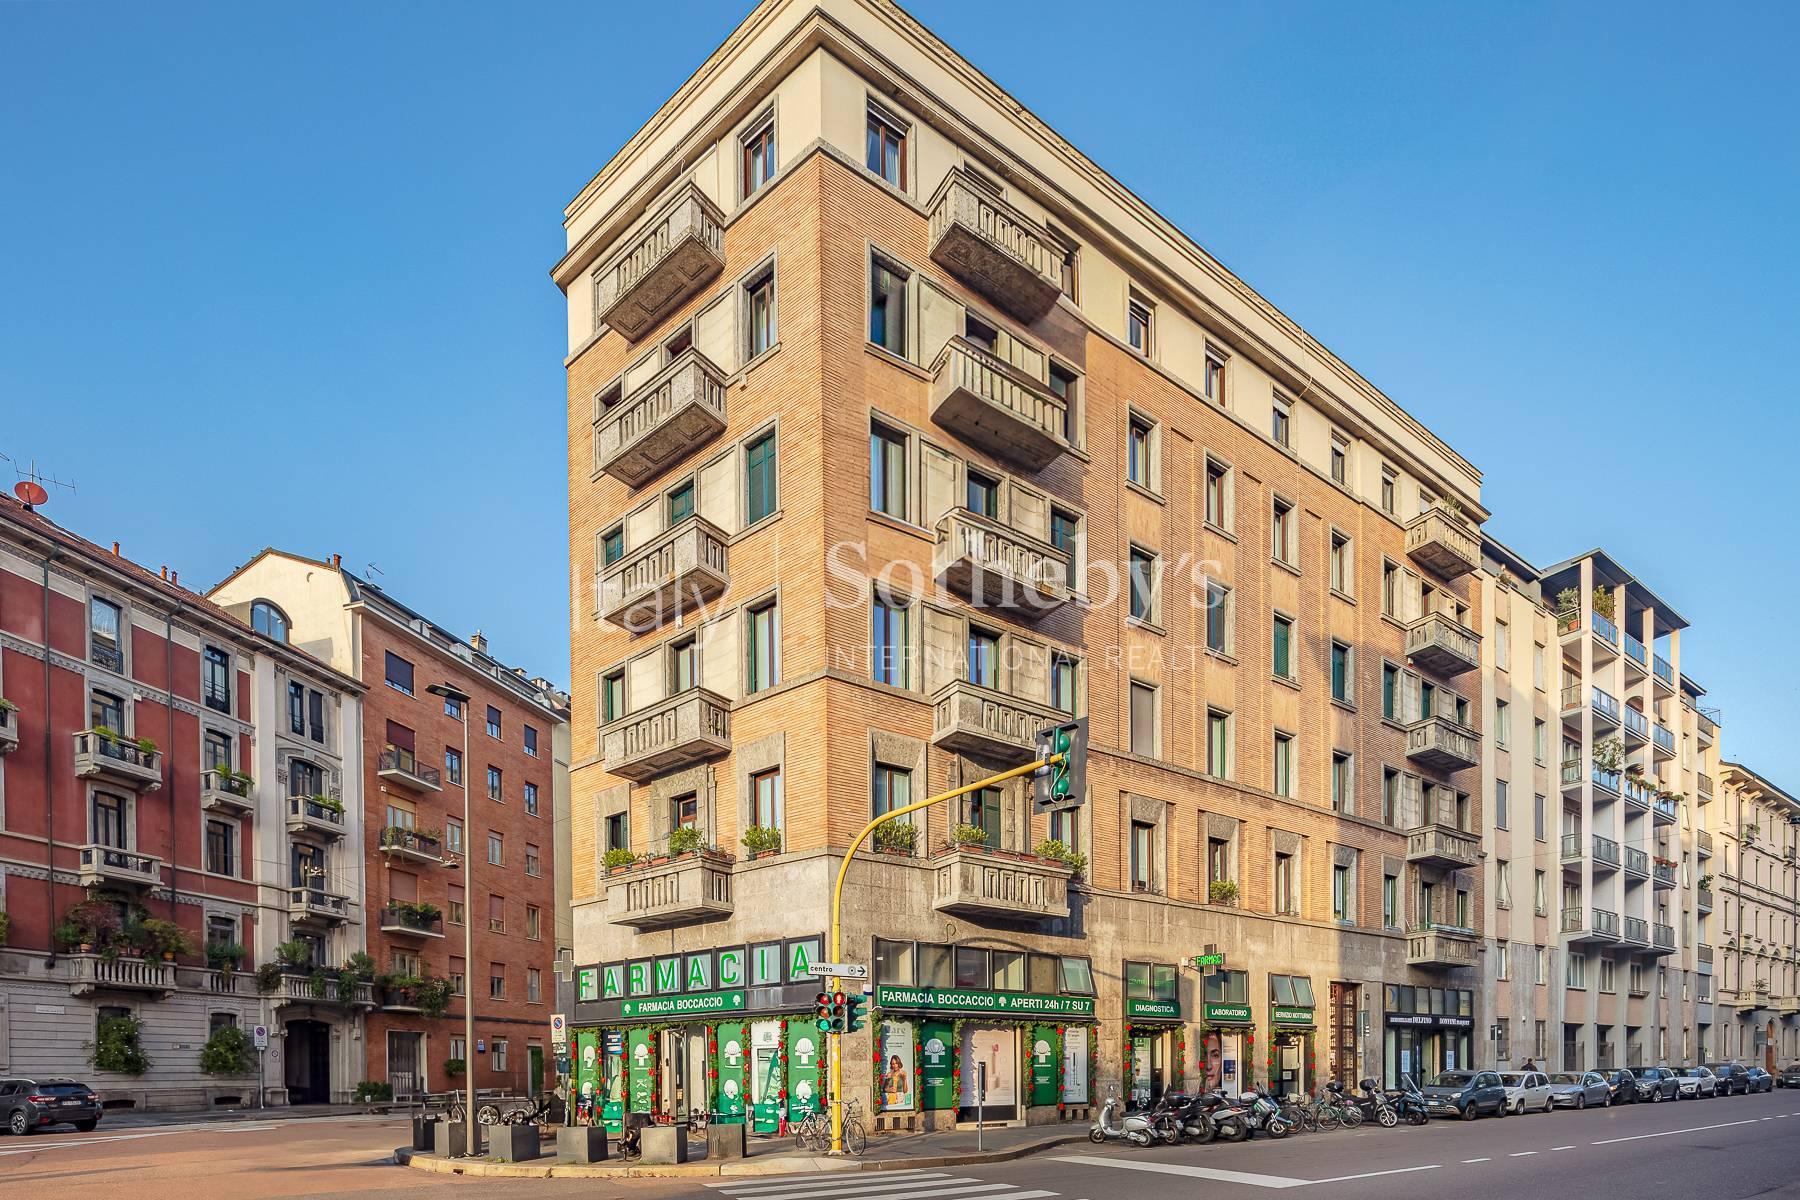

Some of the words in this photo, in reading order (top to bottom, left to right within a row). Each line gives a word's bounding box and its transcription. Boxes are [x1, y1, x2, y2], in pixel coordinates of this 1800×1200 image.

[579, 944, 810, 998] FARMACIA
[810, 965, 833, 973] centro
[881, 990, 935, 1004] FARMACIA
[937, 993, 994, 1007] BOCCACCIO
[638, 1001, 675, 1013] FARMACIA
[676, 997, 723, 1010] BOCCACCIO
[1010, 998, 1043, 1009] APERTI
[1044, 999, 1059, 1010] 24h
[1065, 1000, 1071, 1010] 7
[1072, 1000, 1083, 1011] SU
[1084, 1001, 1090, 1011] 7
[1135, 1004, 1175, 1013] DIAGNOSTICA
[1211, 1008, 1247, 1017] LABORATORIO
[1275, 1011, 1292, 1019] SERVIZIO
[1292, 1012, 1313, 1020] NOTTURNO
